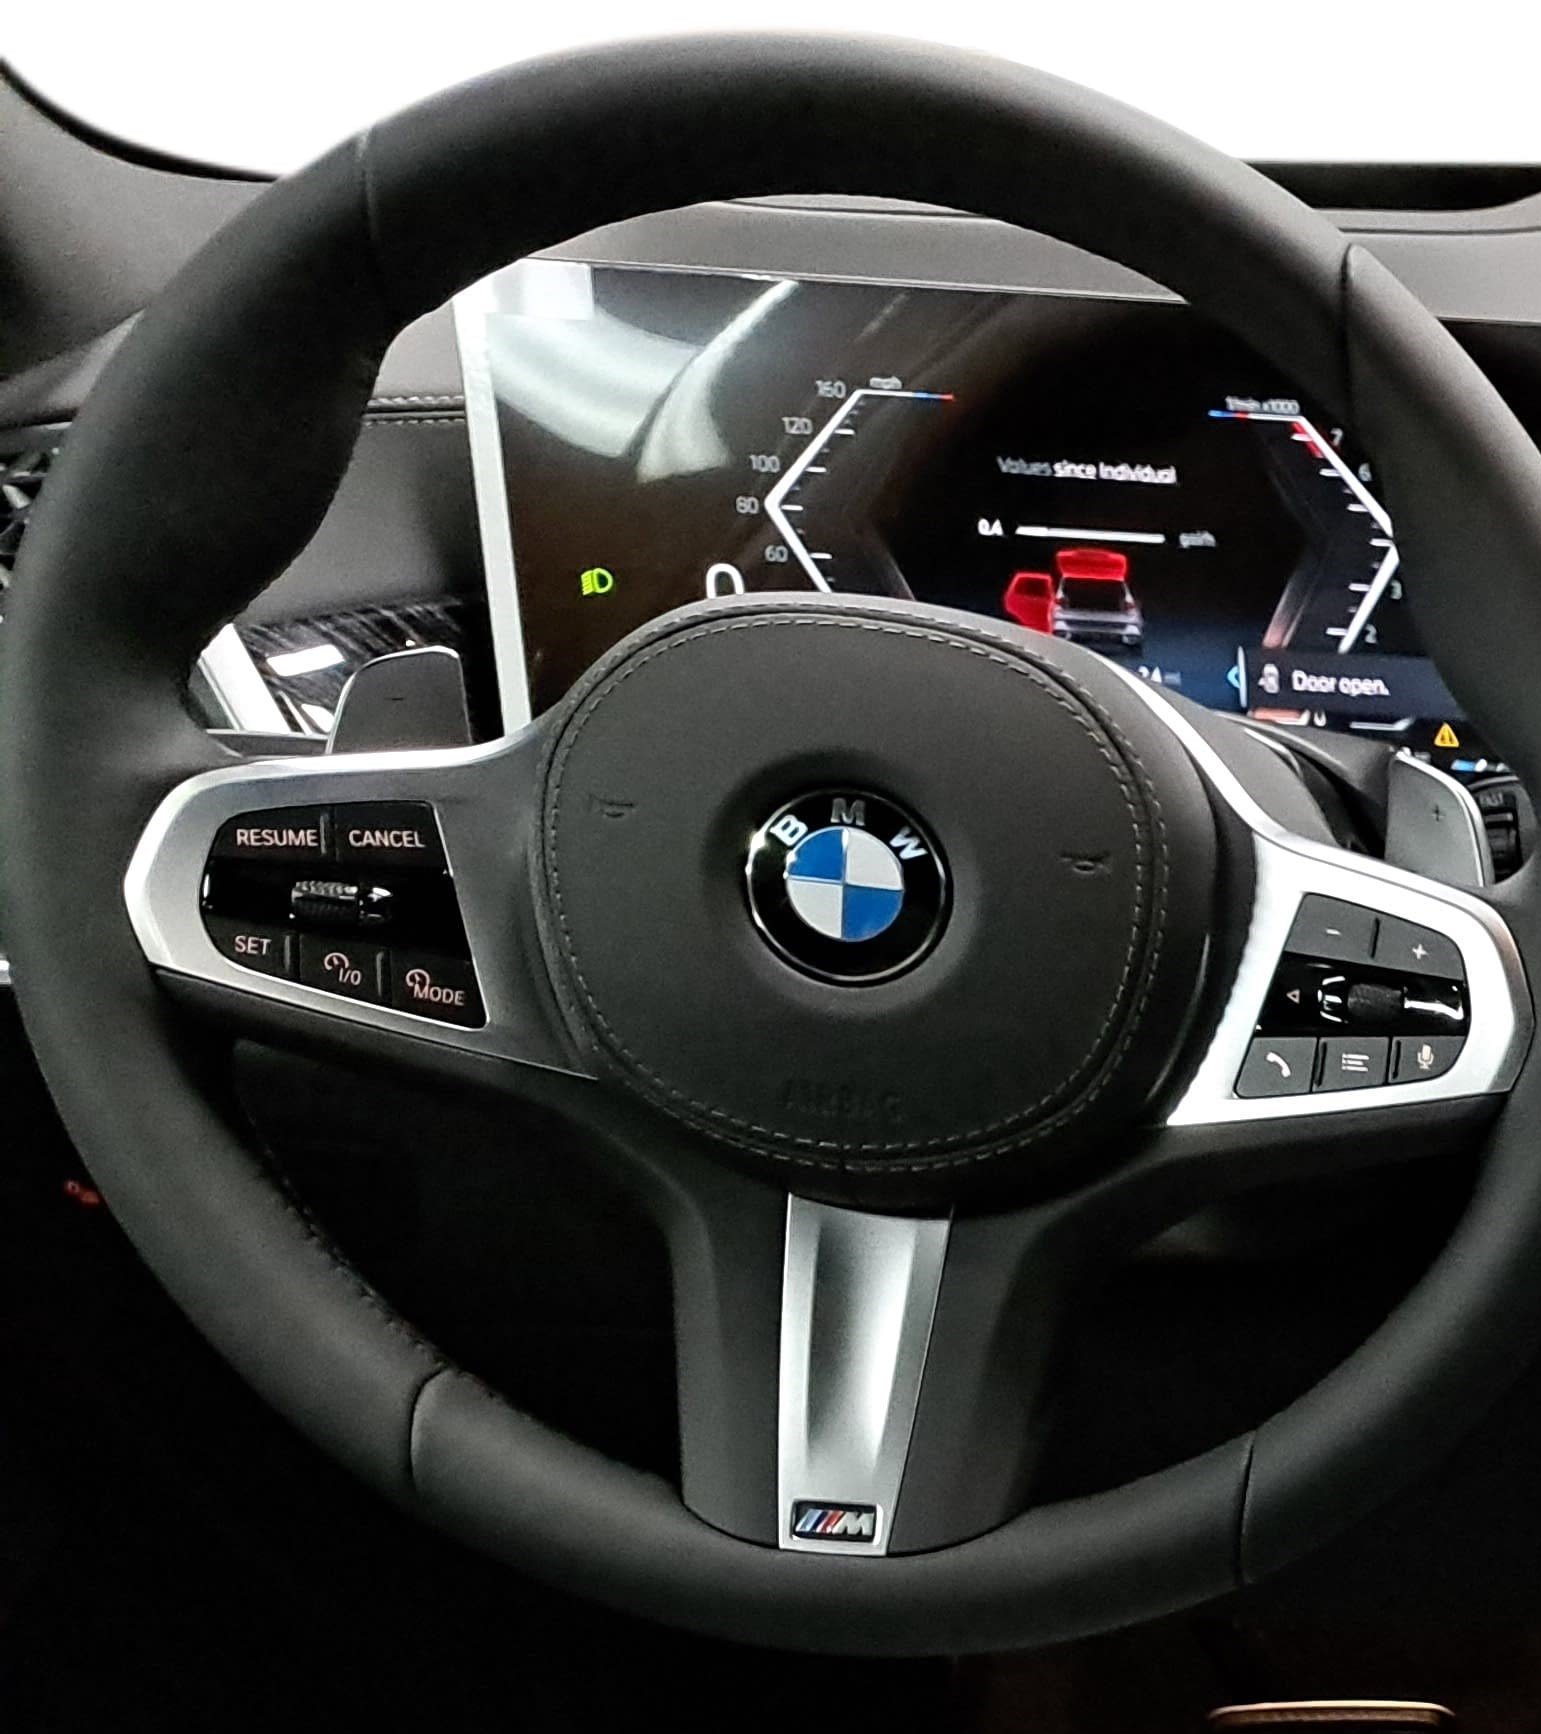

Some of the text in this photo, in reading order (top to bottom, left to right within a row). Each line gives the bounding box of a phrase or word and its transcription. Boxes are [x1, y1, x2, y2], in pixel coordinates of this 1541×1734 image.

[782, 417, 812, 435] 120
[750, 455, 780, 473] 100
[997, 456, 1051, 477] Values
[1053, 460, 1097, 480] since
[736, 497, 759, 514] 80
[765, 546, 788, 562] 60
[1292, 670, 1390, 700] Door open.
[236, 828, 318, 847] RESUME
[349, 829, 425, 848] CANCEL
[770, 798, 927, 861] BMW
[234, 935, 272, 955] SET
[415, 983, 465, 1007] MODE
